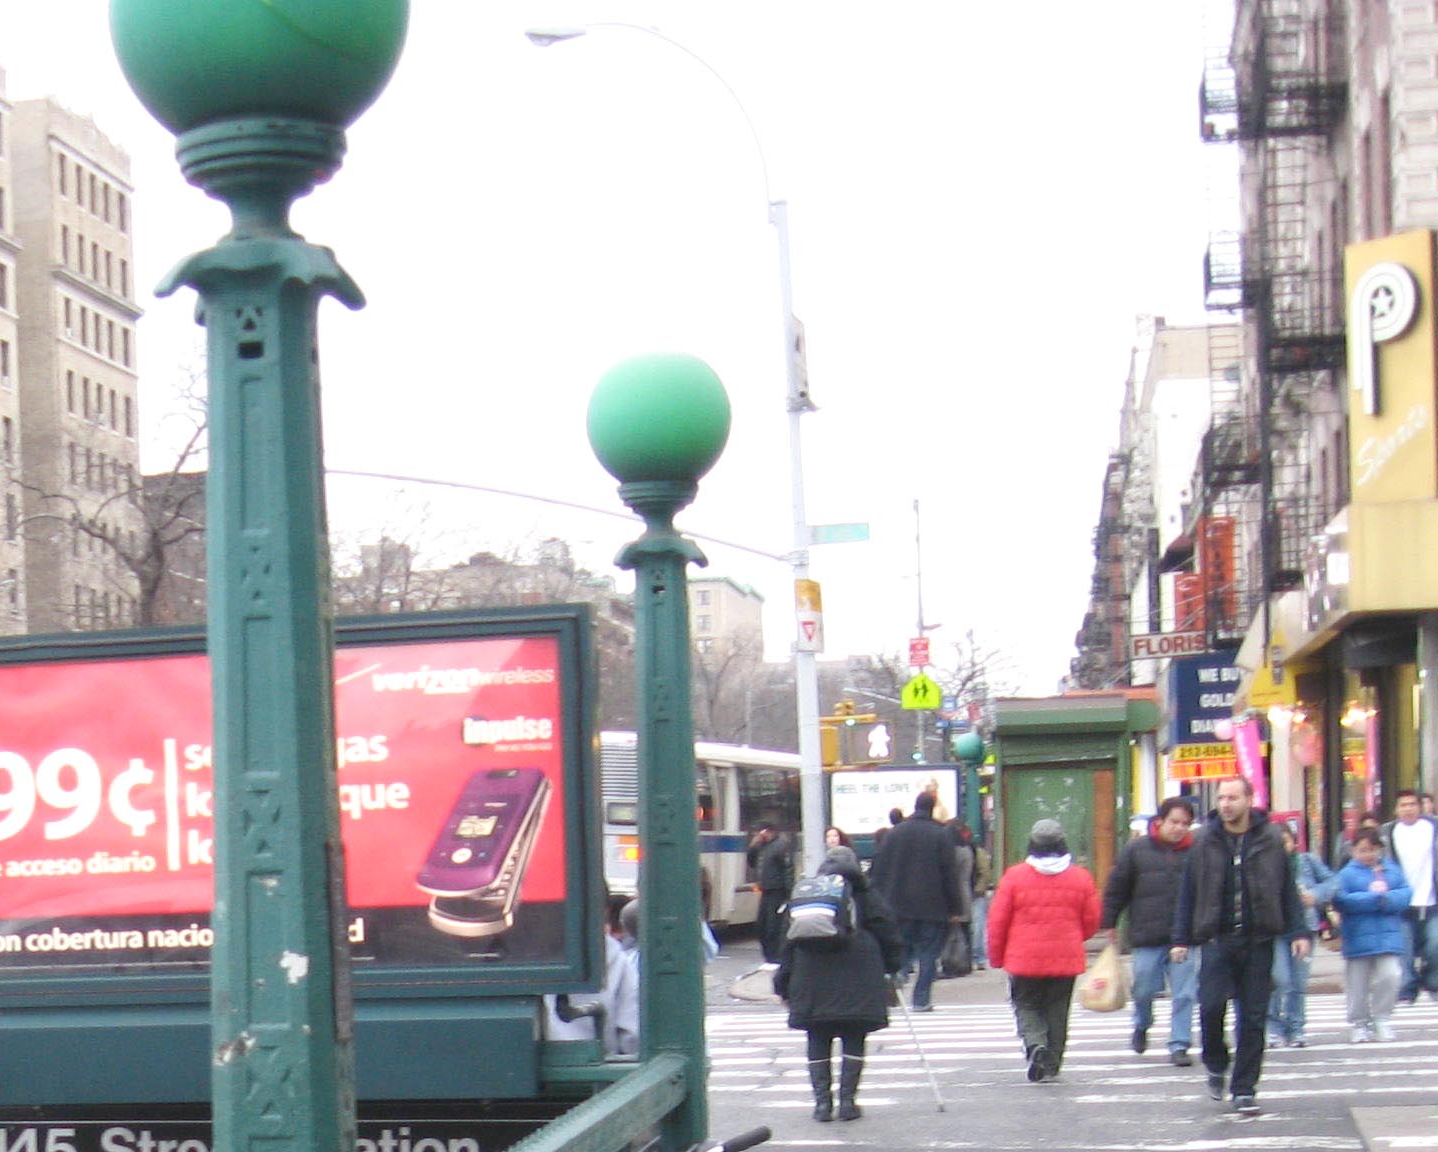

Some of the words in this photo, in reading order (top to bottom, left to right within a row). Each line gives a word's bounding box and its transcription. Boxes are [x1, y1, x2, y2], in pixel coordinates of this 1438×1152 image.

[1133, 634, 1206, 656] FLORIS
[1198, 669, 1219, 683] WE
[340, 782, 410, 820] que
[5, 856, 84, 877] acceso
[85, 851, 157, 875] diario
[25, 927, 144, 951] cobertura
[147, 924, 214, 948] nacio
